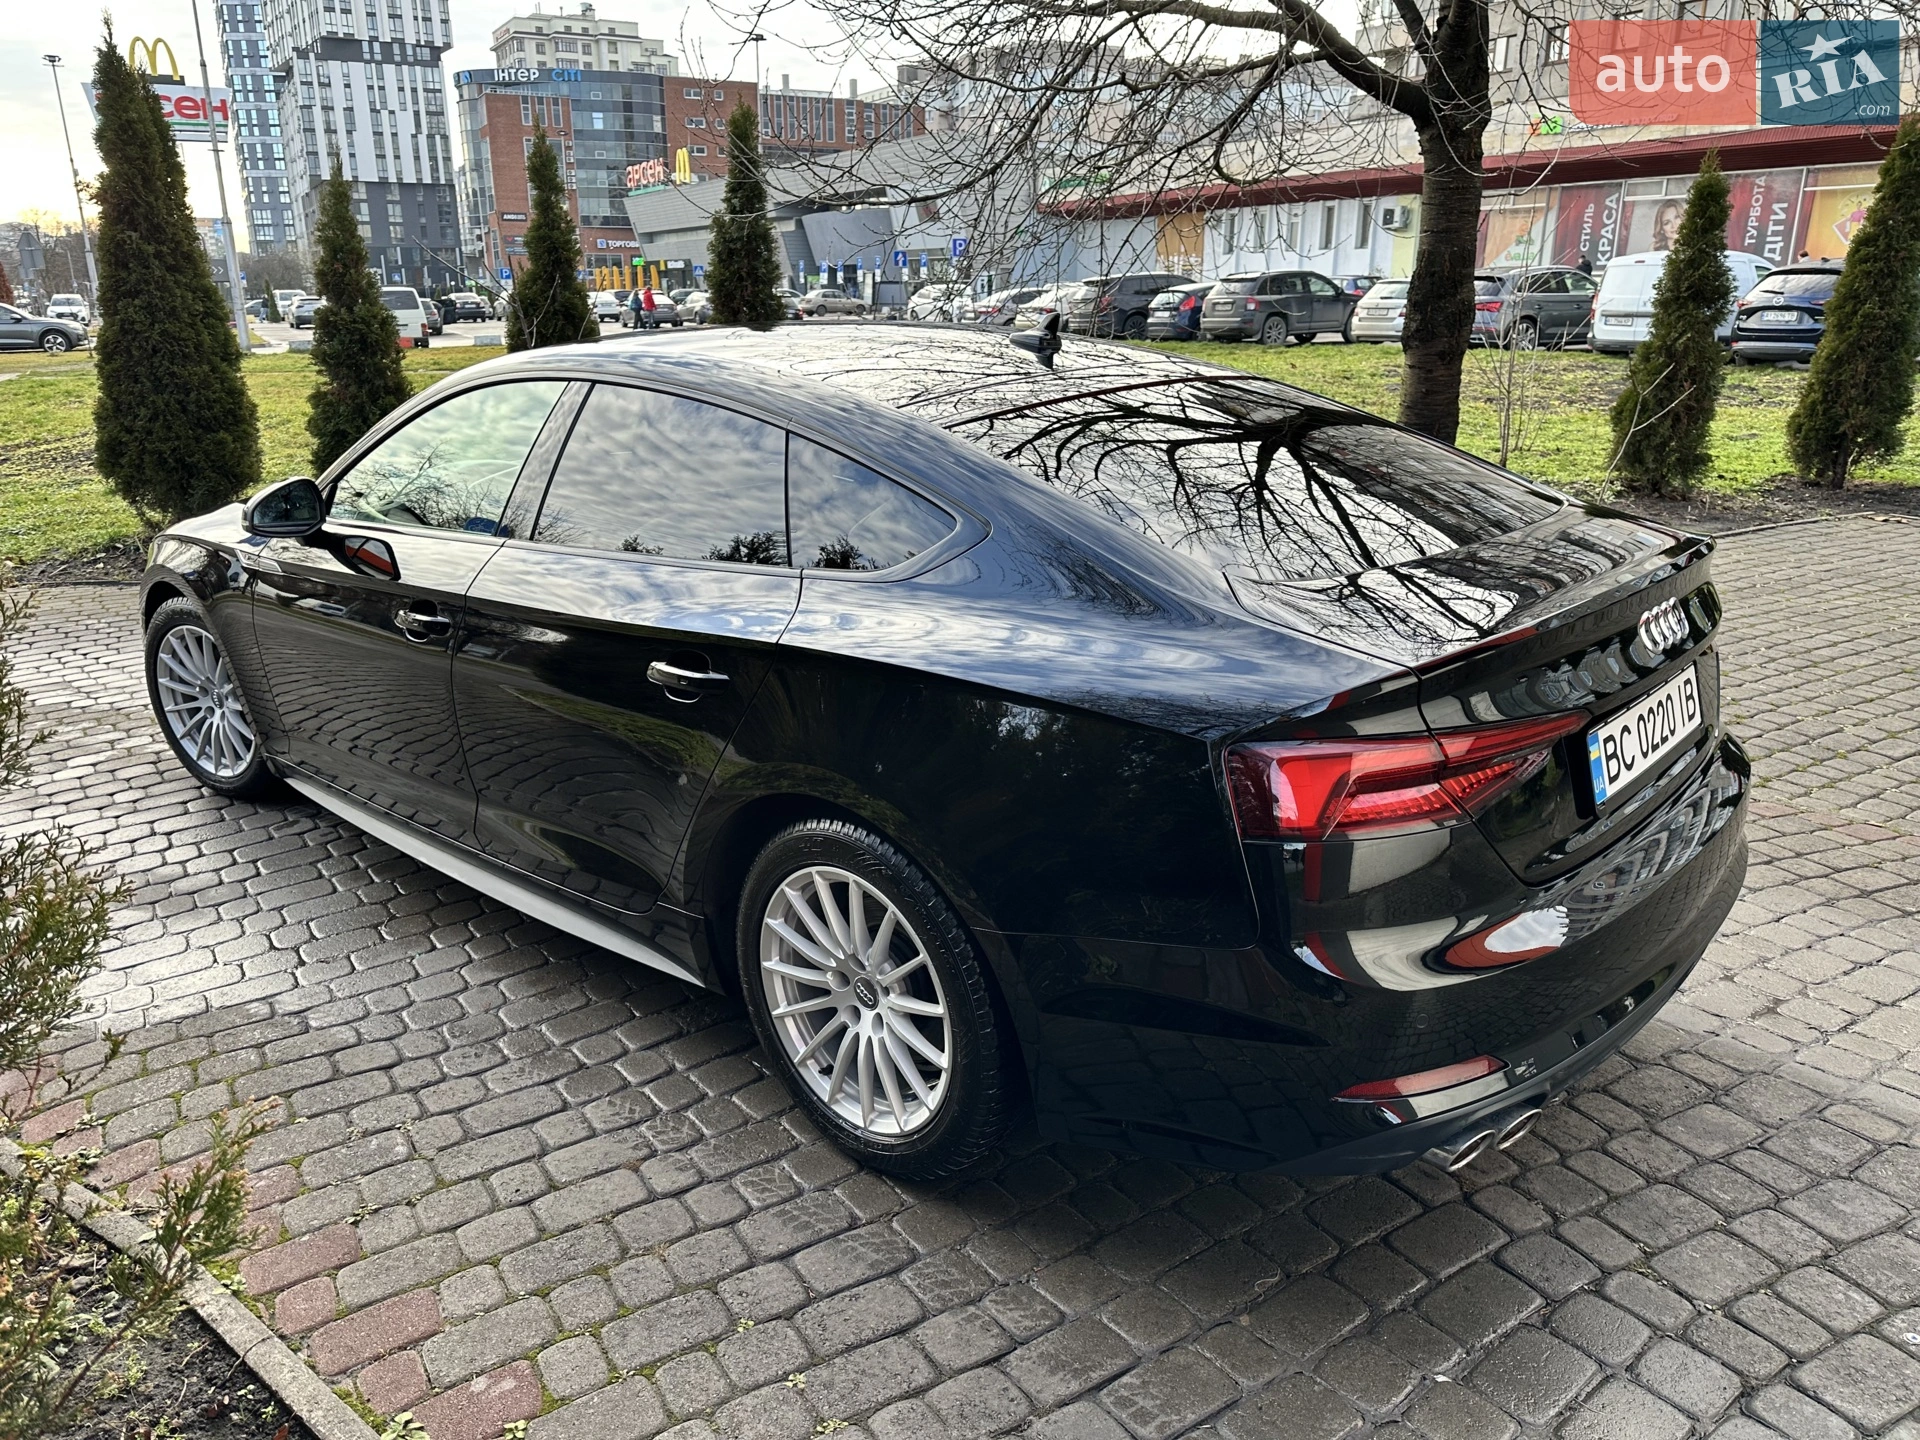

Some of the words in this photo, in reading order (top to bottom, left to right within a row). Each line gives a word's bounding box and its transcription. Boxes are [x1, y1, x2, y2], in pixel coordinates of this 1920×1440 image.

[1580, 203, 1595, 251] СТИЛЬ
[1596, 192, 1619, 266] КРАСА
[1744, 175, 1767, 246] ТУРБОТА
[1763, 203, 1788, 260] ДІТИ
[956, 240, 965, 255] P
[1603, 725, 1635, 785] BC
[1637, 693, 1676, 759] 0220
[1678, 677, 1697, 728] IB
[1594, 779, 1605, 794] UA
